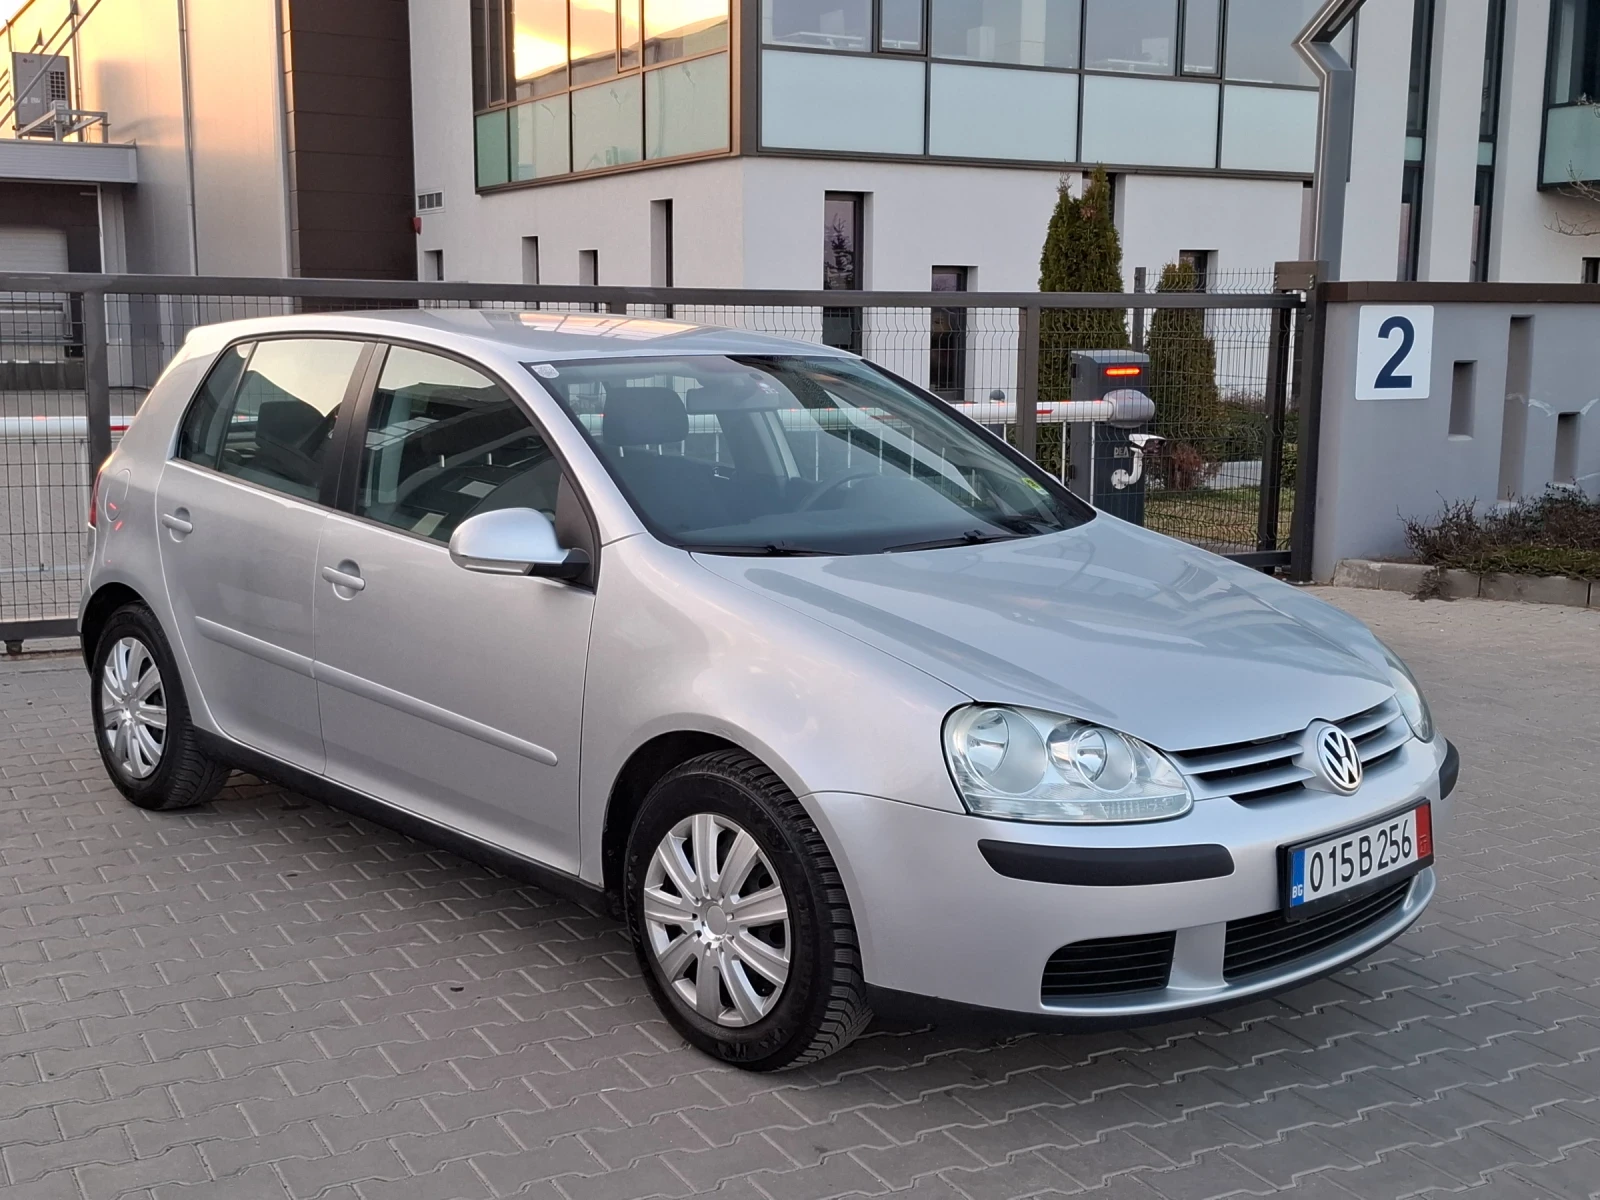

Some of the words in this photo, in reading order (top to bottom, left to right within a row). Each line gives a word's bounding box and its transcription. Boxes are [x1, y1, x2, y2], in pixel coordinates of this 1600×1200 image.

[1374, 316, 1415, 389] 2
[1292, 884, 1303, 898] BG
[1310, 819, 1412, 892] 015B256
